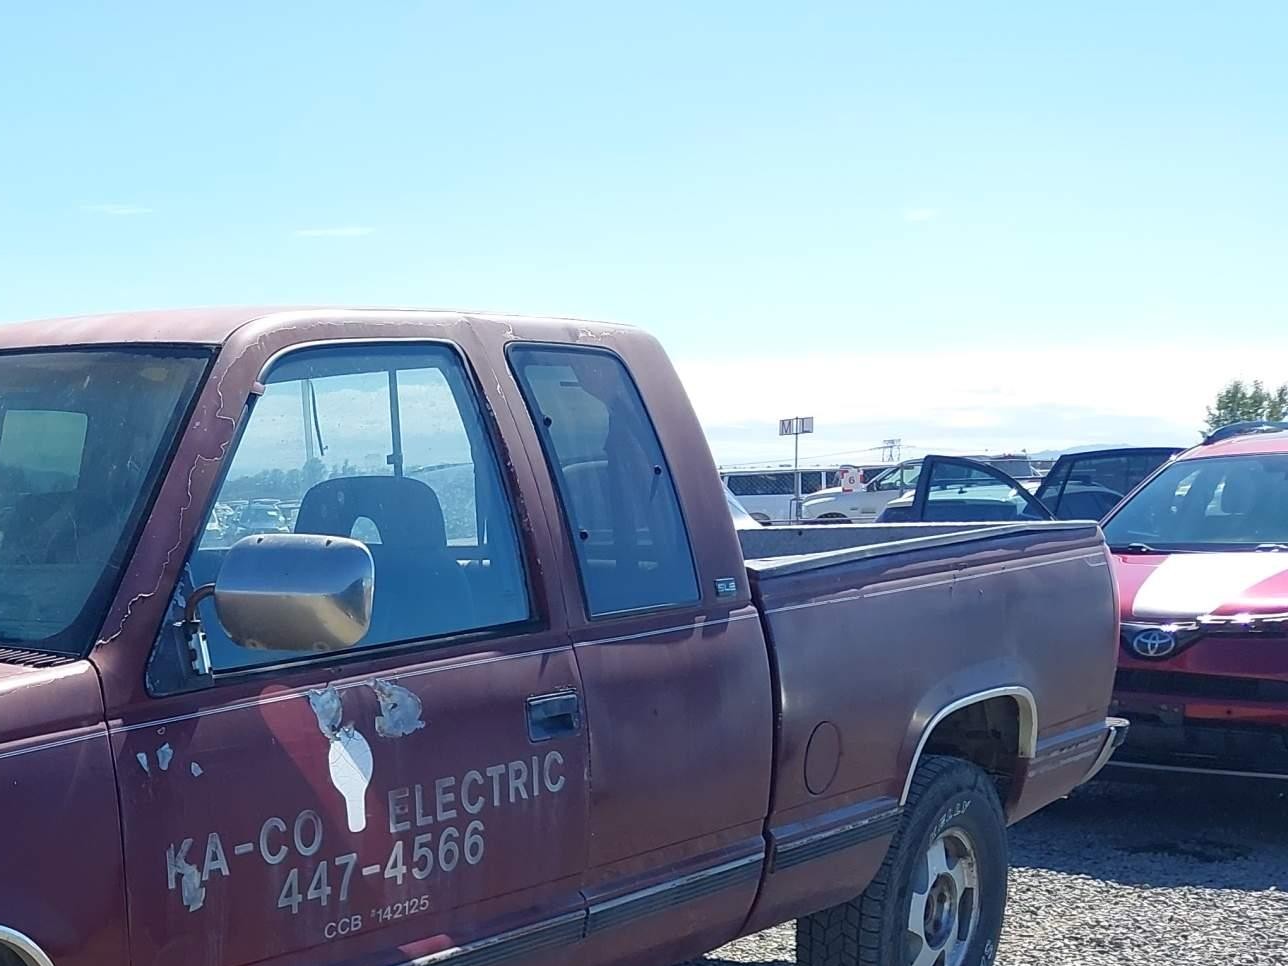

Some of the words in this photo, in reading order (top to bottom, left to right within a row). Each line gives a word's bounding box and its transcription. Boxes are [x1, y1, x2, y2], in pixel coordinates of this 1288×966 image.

[848, 476, 855, 484] 6
[165, 810, 323, 890] KA-CO
[388, 750, 566, 833] ELECTRIC
[278, 820, 484, 914] 447-4566
[324, 915, 362, 938] CCB
